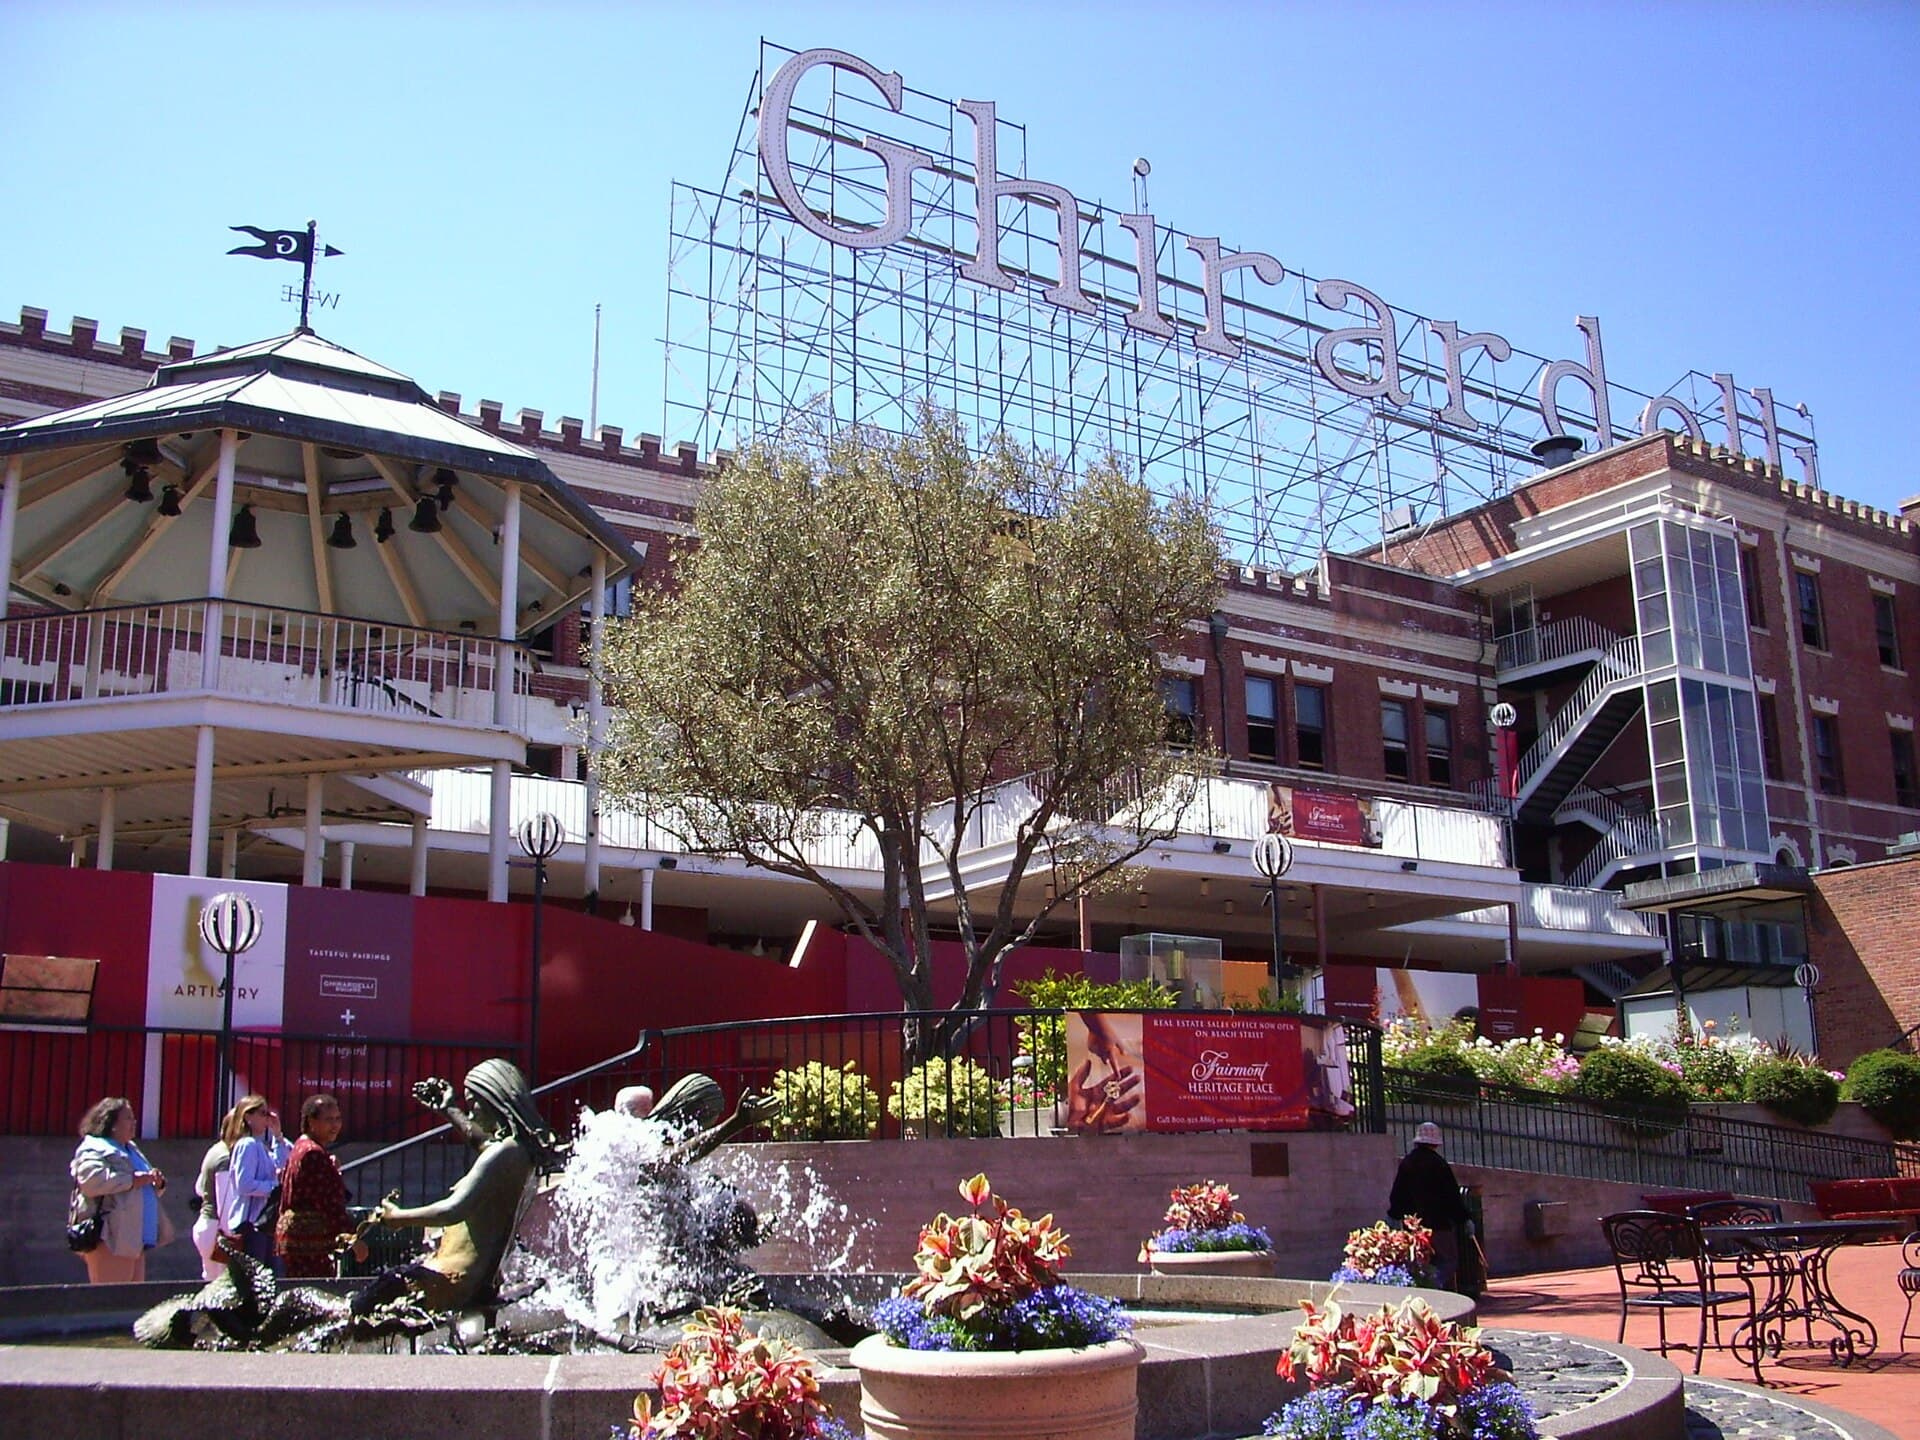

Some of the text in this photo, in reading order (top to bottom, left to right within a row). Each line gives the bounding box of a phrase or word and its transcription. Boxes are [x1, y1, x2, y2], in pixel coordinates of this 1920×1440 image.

[174, 984, 259, 1000] ARTISRY
[1153, 1019, 1294, 1031] REAL ESTATE SALES OFFICE NOW OPEN
[1195, 1030, 1264, 1039] ON BEACH STREET
[1191, 1050, 1270, 1082] Fairmont
[1188, 1081, 1274, 1094] HERITAGE PLACE
[1156, 1115, 1170, 1123] Call
